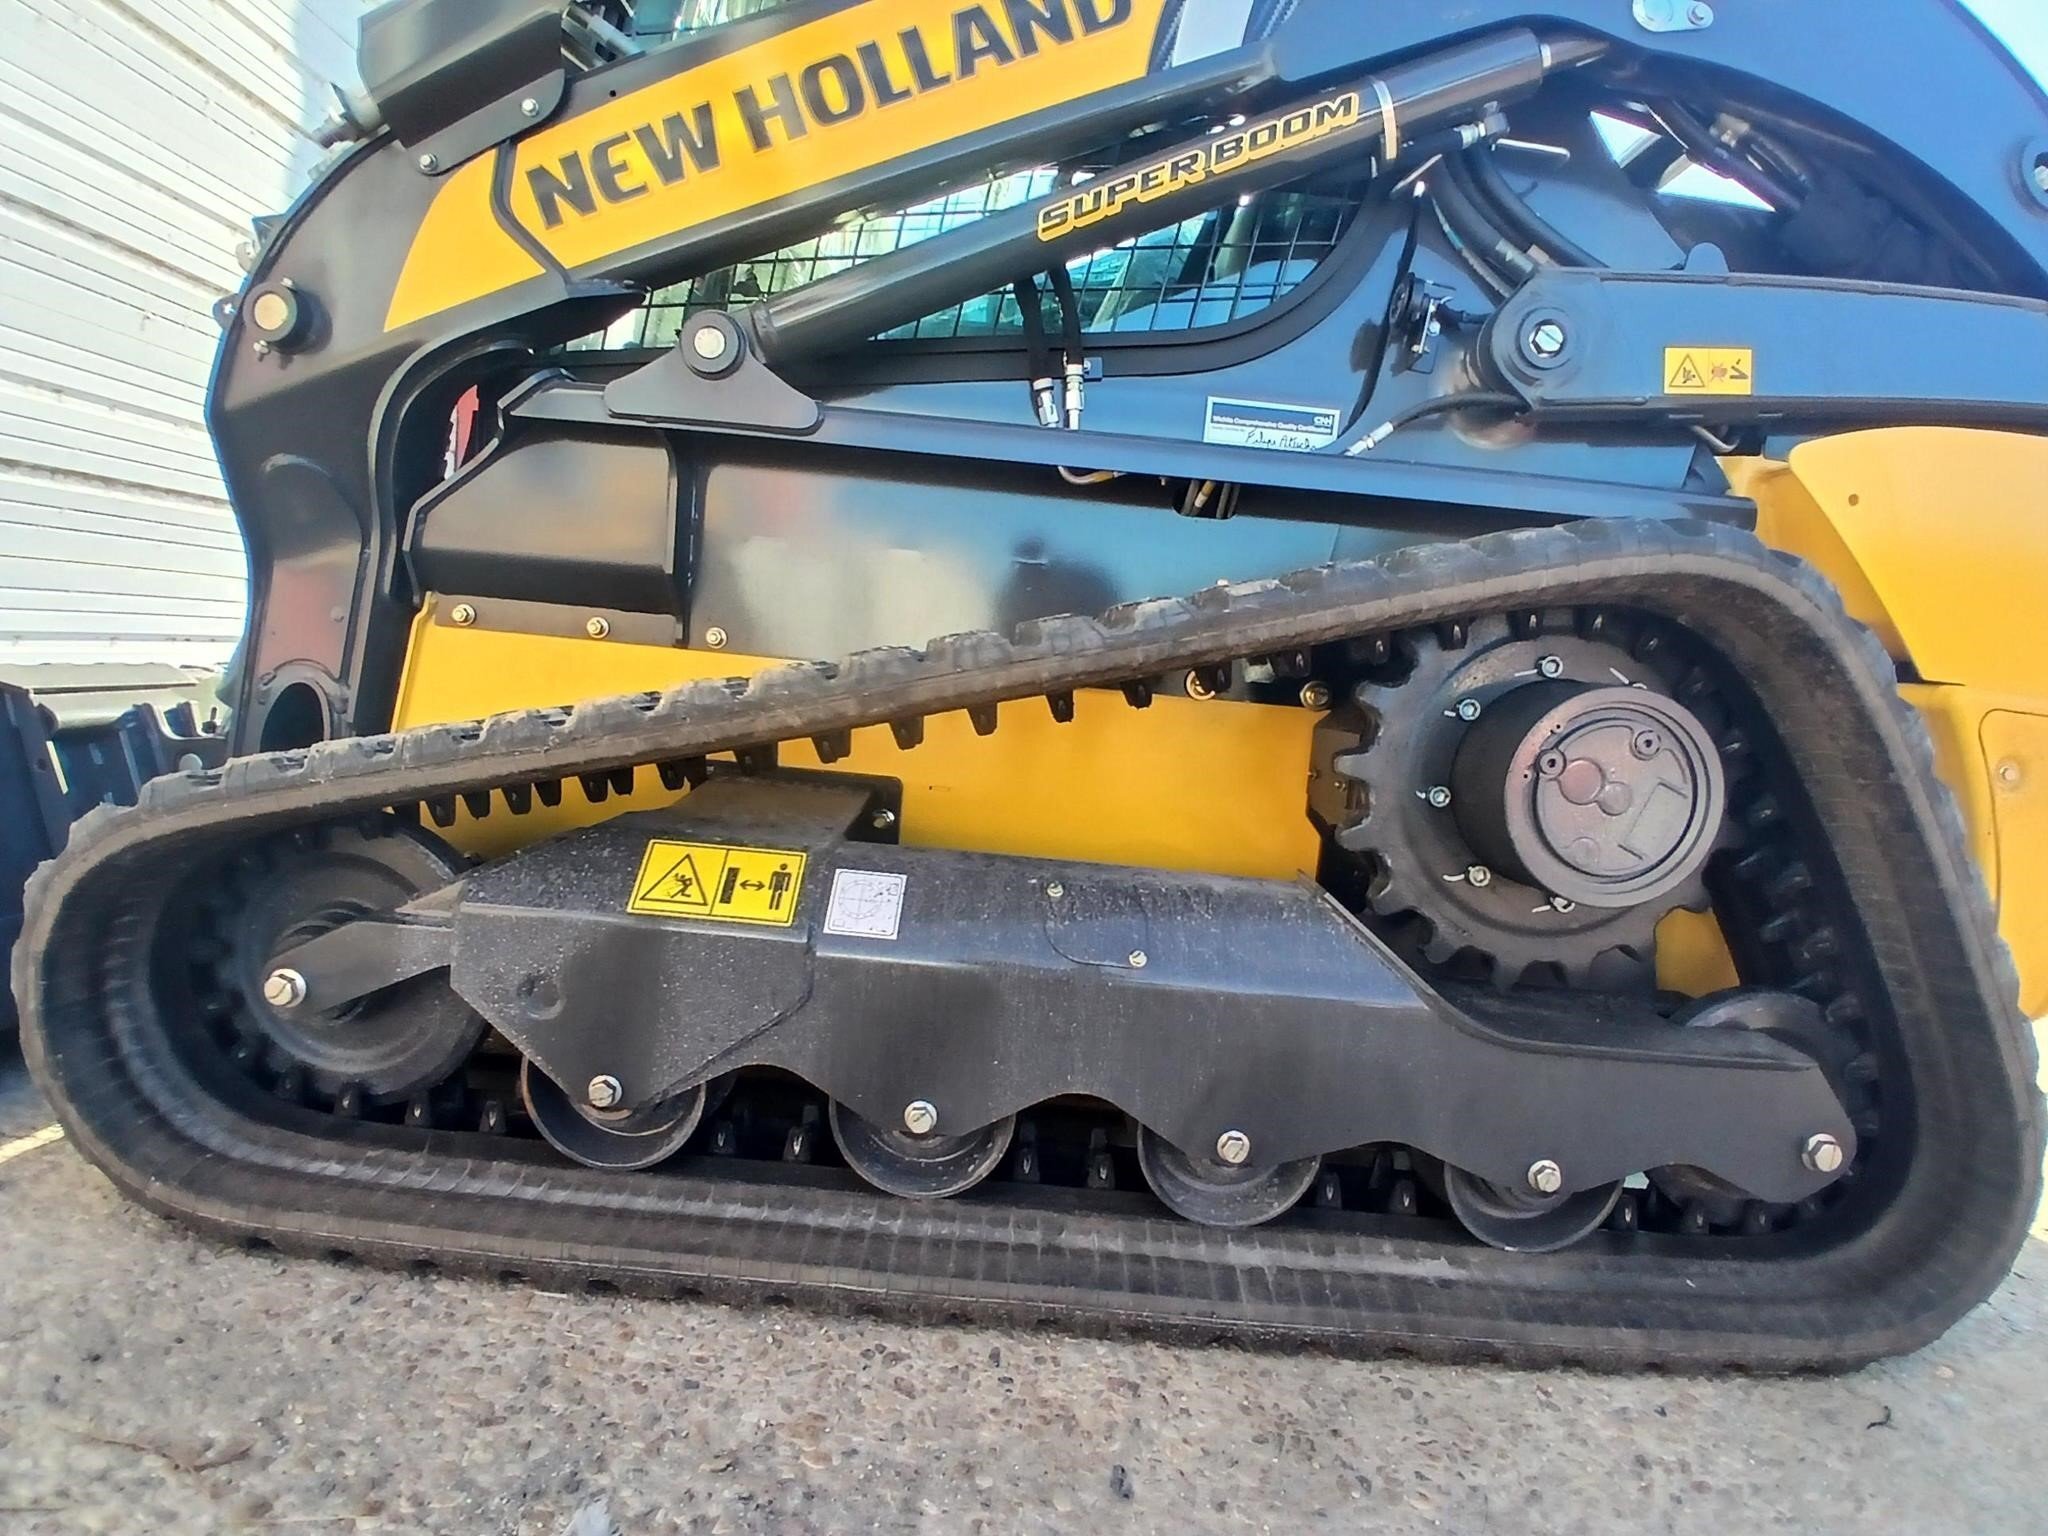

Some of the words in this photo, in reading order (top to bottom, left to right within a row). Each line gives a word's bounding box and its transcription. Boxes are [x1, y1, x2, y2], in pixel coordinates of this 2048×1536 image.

[526, 99, 720, 230] NEW
[733, 0, 1132, 154] HOLLAND
[1037, 149, 1206, 241] SUPER
[1210, 92, 1360, 175] BOOM
